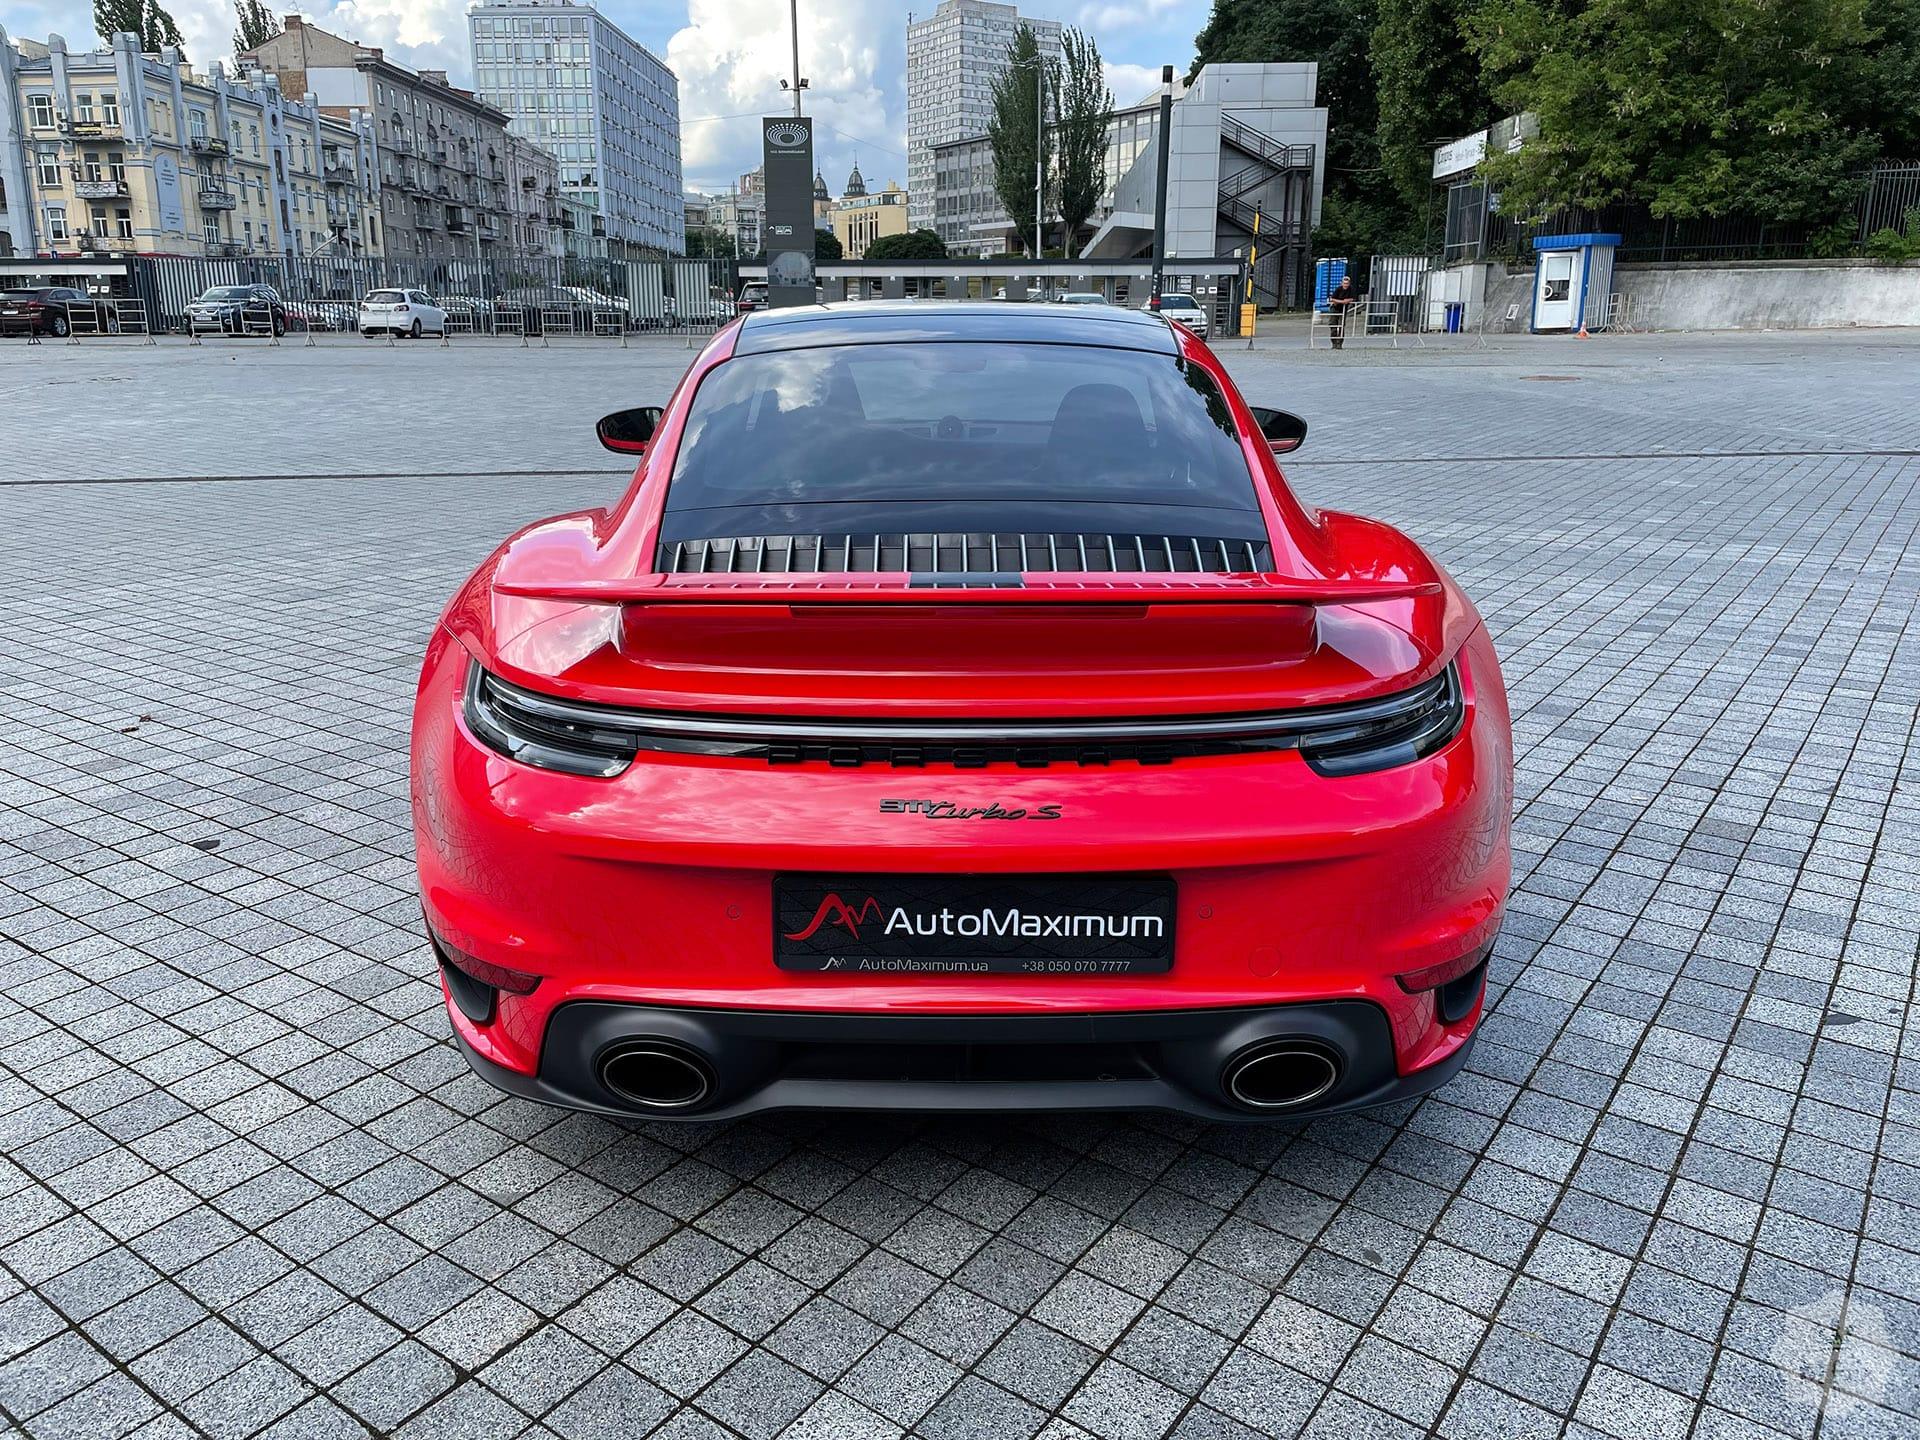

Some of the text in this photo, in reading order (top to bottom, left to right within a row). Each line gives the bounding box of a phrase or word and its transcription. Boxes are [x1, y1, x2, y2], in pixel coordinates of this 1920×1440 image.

[768, 744, 1172, 767] PORSCHE
[880, 799, 1062, 820] 911 turbo S
[884, 907, 1163, 937] AutoMaximum
[858, 958, 989, 972] AutoMaximum.ua
[1022, 961, 1045, 972] +38
[1048, 961, 1071, 972] 050
[1074, 961, 1097, 972] 070
[1100, 961, 1131, 972] 7777
